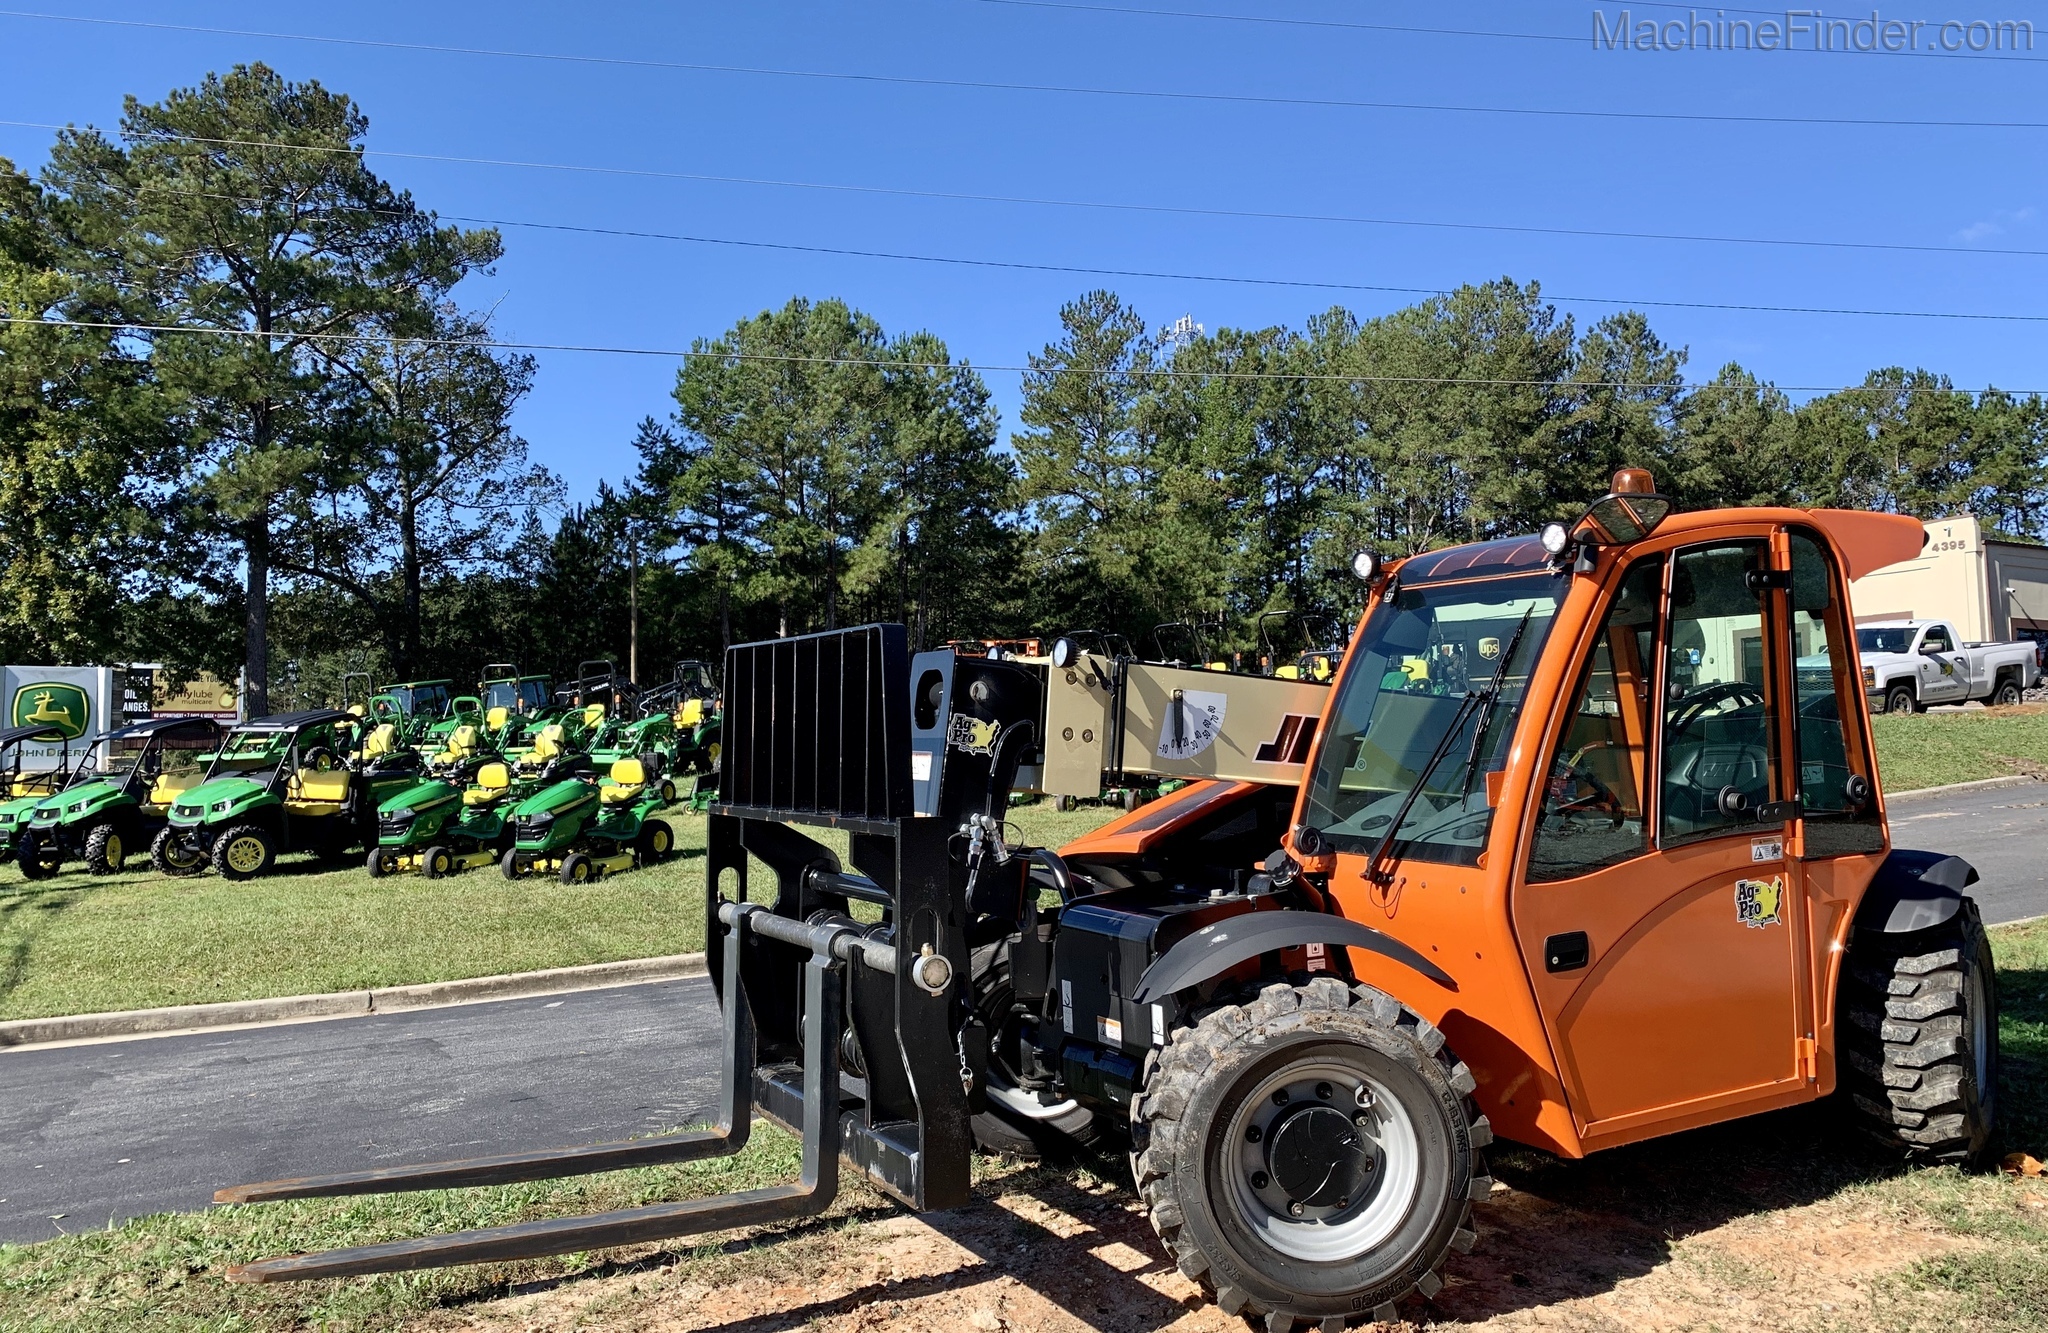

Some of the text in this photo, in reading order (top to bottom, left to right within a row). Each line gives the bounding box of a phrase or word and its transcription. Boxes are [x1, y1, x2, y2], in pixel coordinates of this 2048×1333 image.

[1932, 540, 1966, 552] 4395
[1480, 644, 1498, 657] ups
[124, 689, 137, 700] OIL
[193, 690, 213, 699] lube
[181, 698, 213, 706] multicare
[952, 729, 977, 744] Pro
[1739, 900, 1762, 919] Pro
